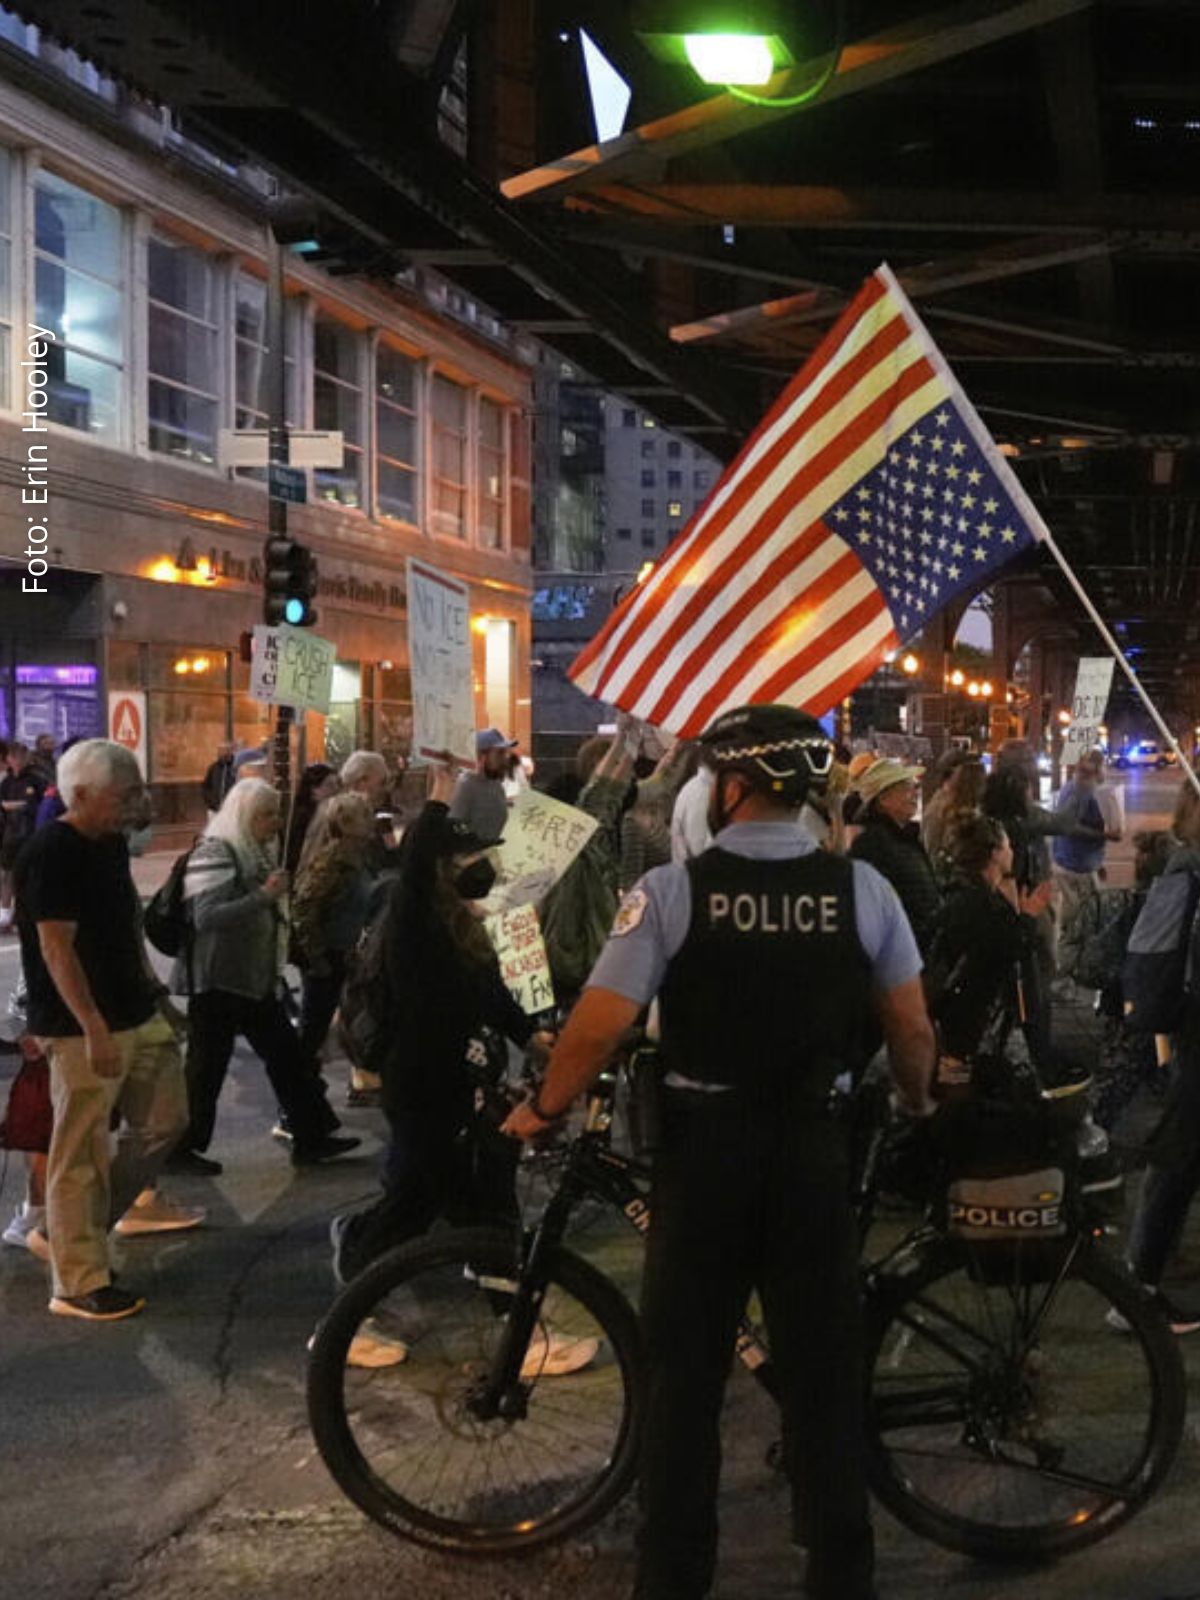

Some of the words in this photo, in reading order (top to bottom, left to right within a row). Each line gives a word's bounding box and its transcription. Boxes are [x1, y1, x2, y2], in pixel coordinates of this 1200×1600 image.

[286, 635, 329, 677] CRUSH
[292, 668, 318, 701] ICE
[709, 893, 838, 932] POLICE
[951, 1206, 1059, 1228] POLICE
